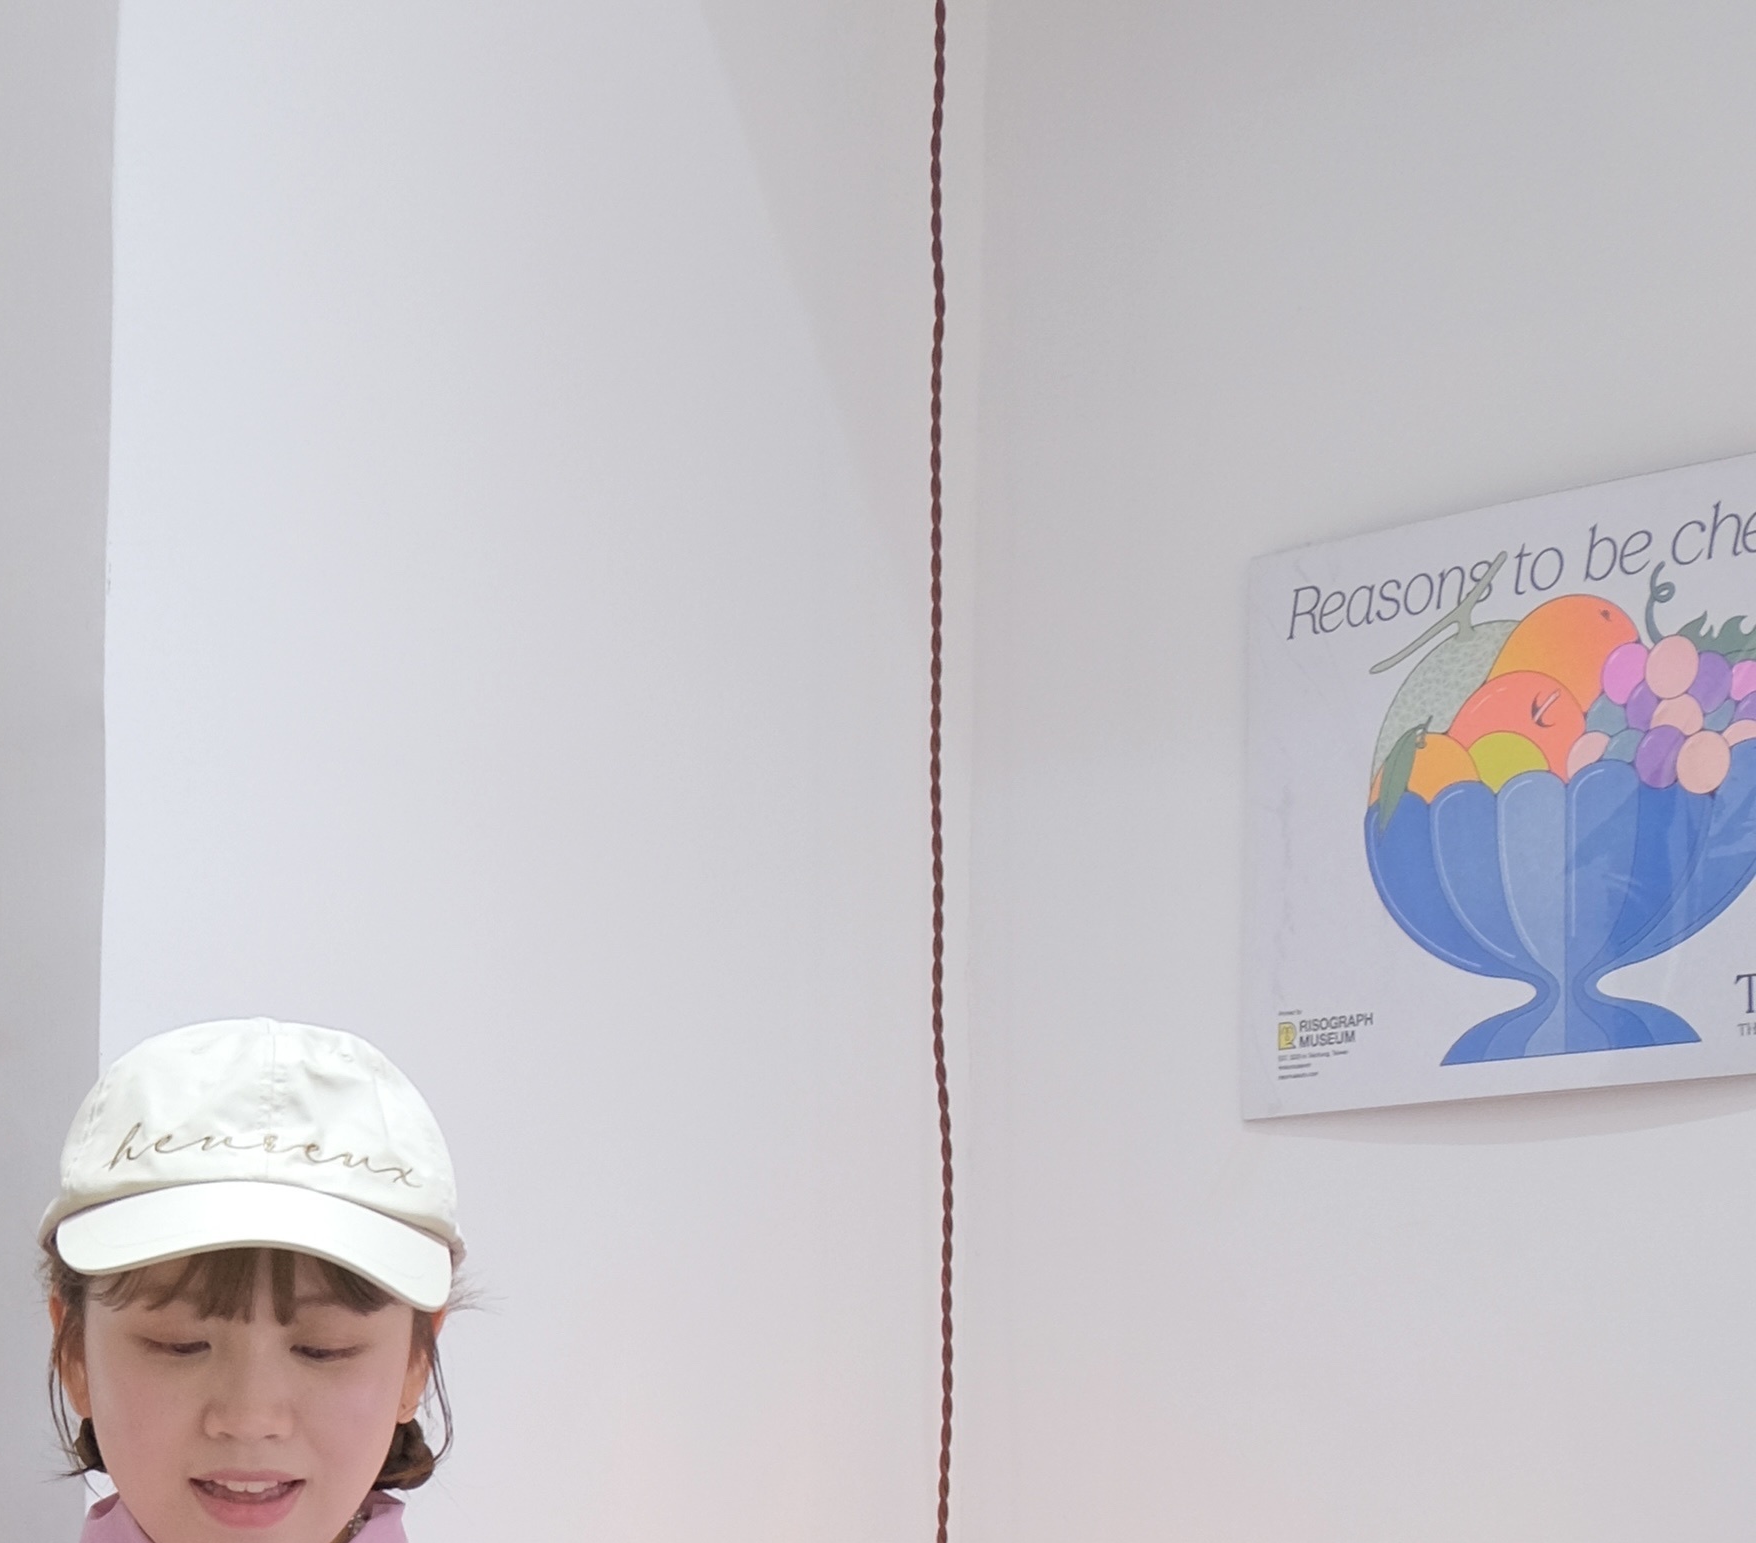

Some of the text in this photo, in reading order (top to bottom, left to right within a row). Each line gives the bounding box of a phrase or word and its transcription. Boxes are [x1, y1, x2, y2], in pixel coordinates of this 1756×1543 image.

[1286, 556, 1494, 640] Reasons
[1512, 543, 1565, 595] to
[1584, 523, 1652, 583] be
[1299, 1012, 1374, 1032] RISOGRAPH
[1299, 1030, 1356, 1048] MUSEUM
